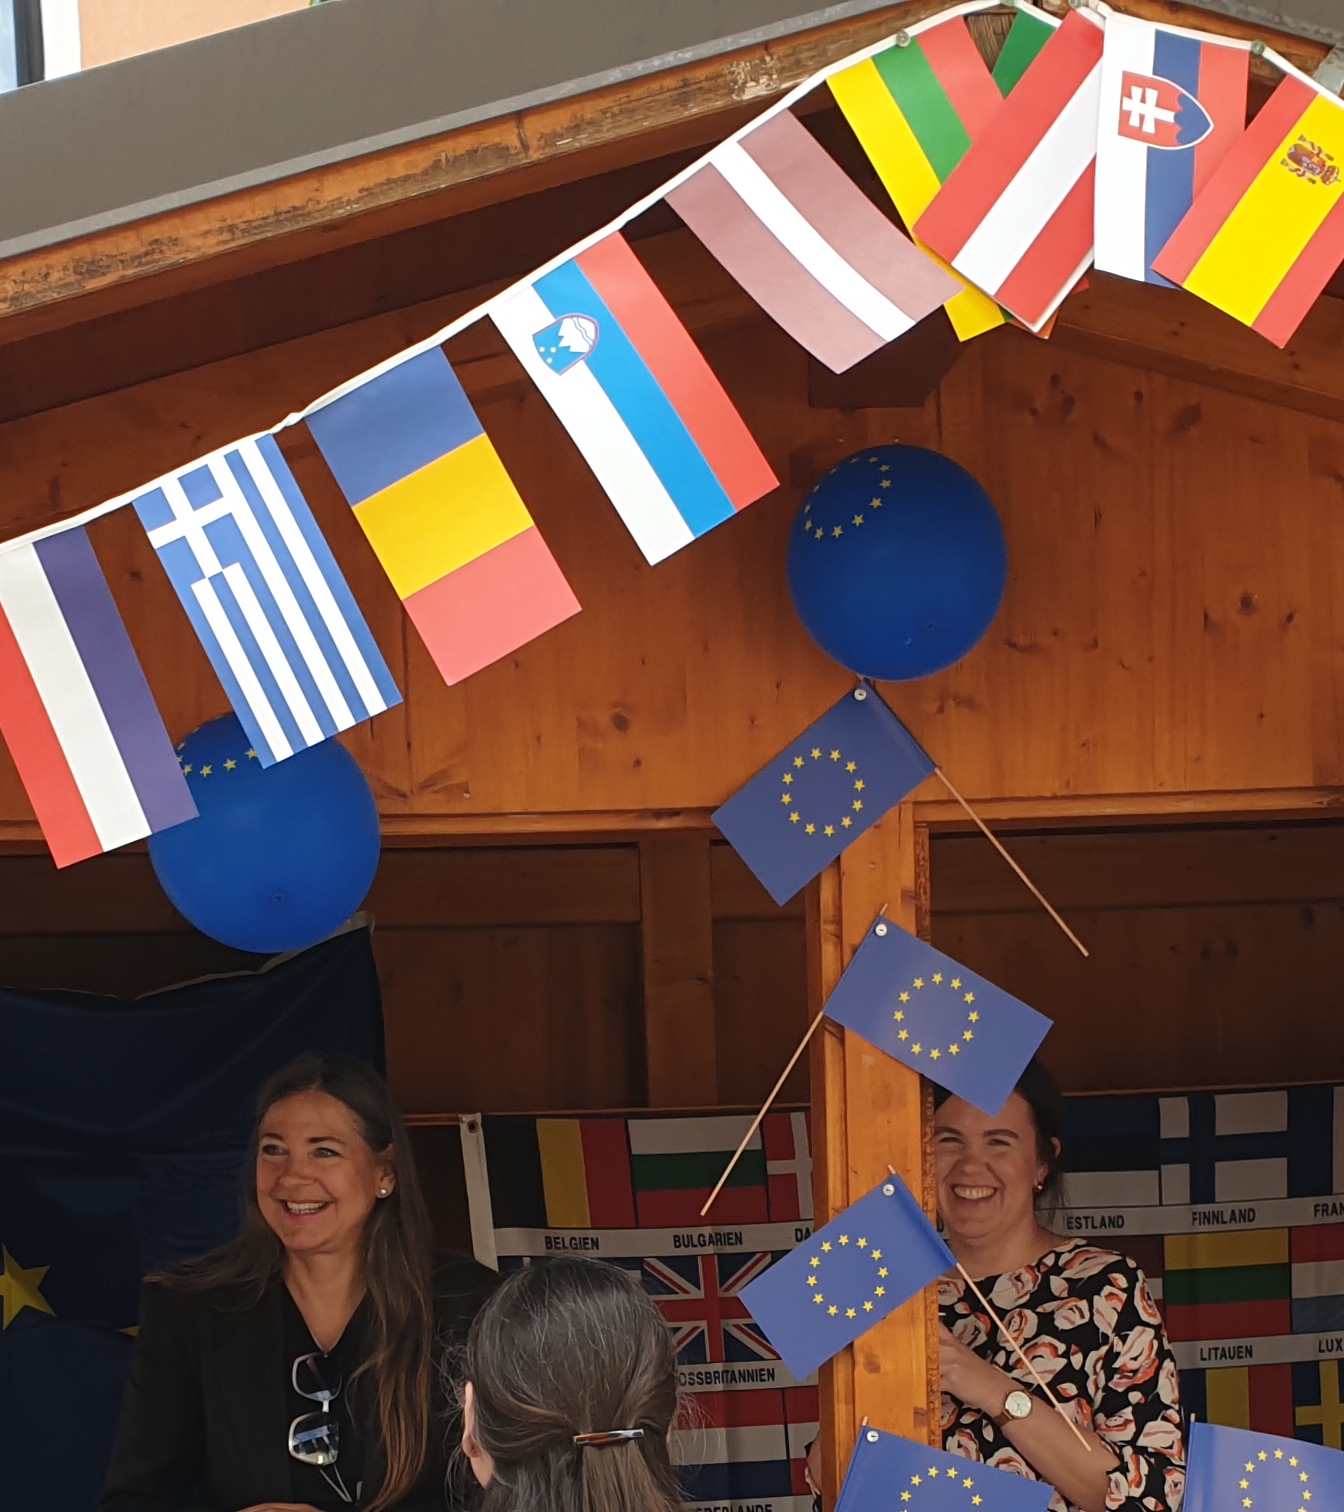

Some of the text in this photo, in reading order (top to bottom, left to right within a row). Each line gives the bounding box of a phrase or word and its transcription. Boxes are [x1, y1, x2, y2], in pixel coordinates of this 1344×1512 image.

[1066, 1215, 1125, 1230] ESTLAND
[1191, 1207, 1256, 1226] FINNLAND
[544, 1236, 600, 1251] BELGIEN
[672, 1231, 743, 1249] BULGARIEN
[1199, 1345, 1253, 1361] LITAUEN
[679, 1367, 776, 1387] OSSBRITANNIEN
